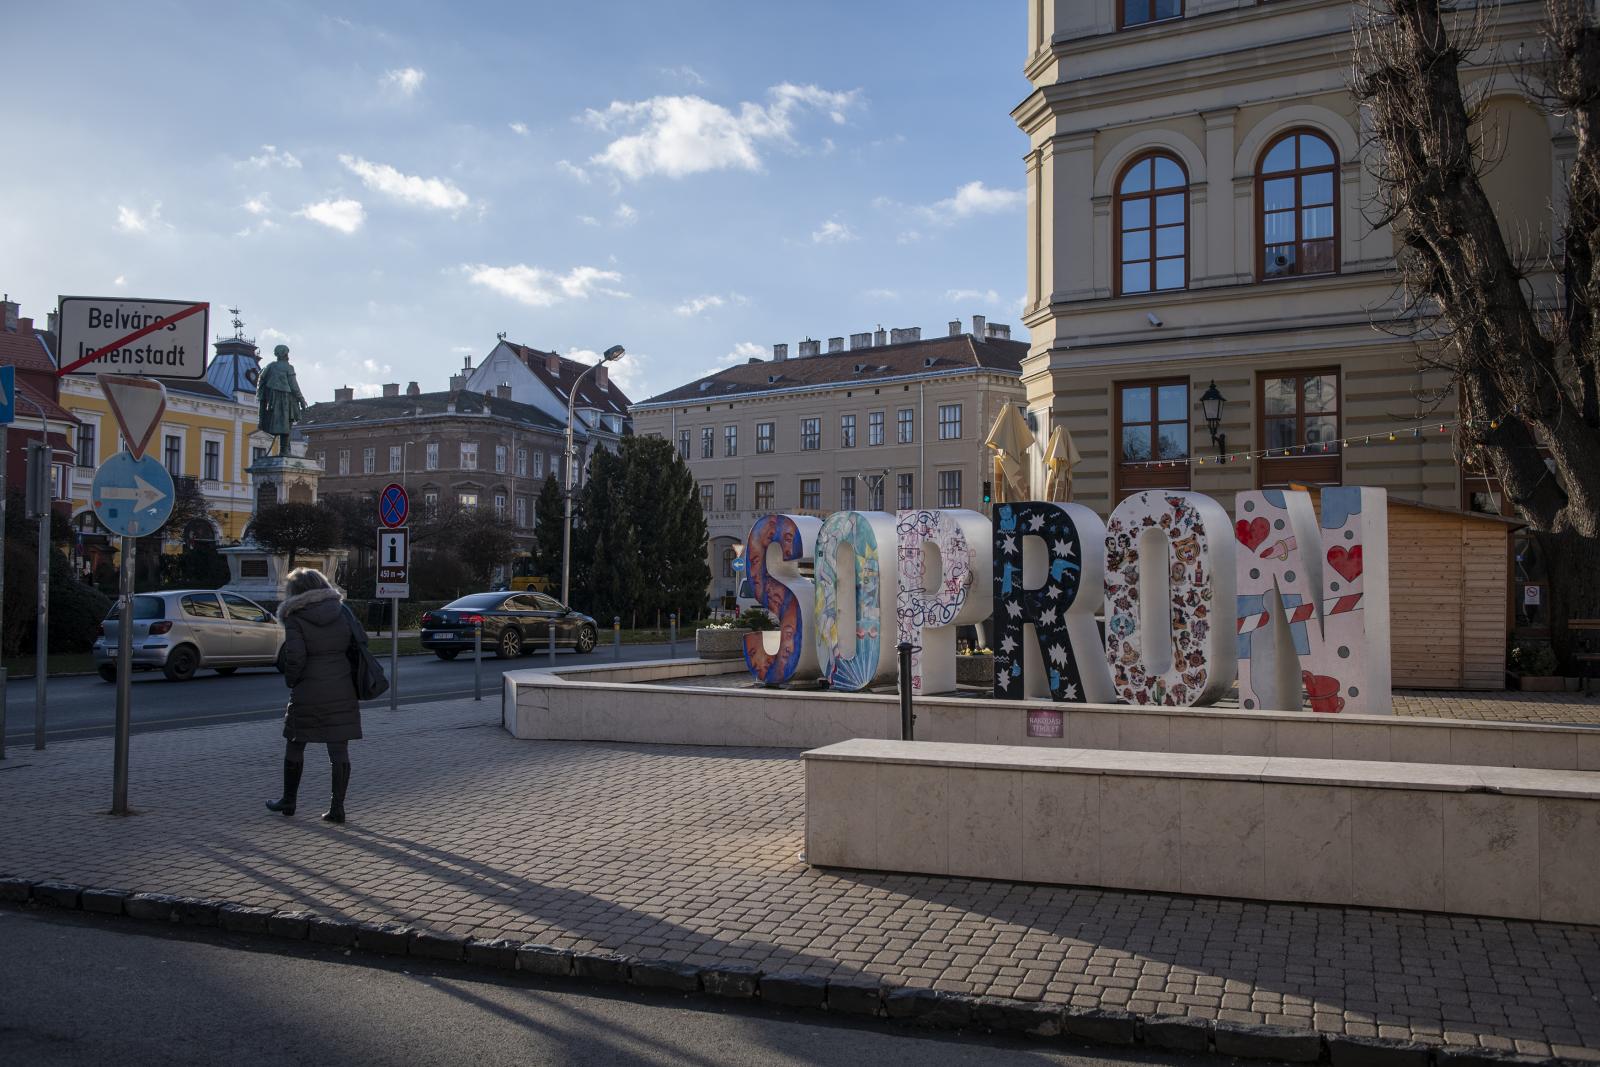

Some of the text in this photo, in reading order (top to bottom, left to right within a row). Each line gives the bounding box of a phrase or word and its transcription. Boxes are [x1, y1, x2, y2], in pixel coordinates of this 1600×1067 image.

[88, 307, 177, 331] Belváros
[79, 341, 185, 366] Innenstadt
[744, 487, 1391, 715] SOPRON
